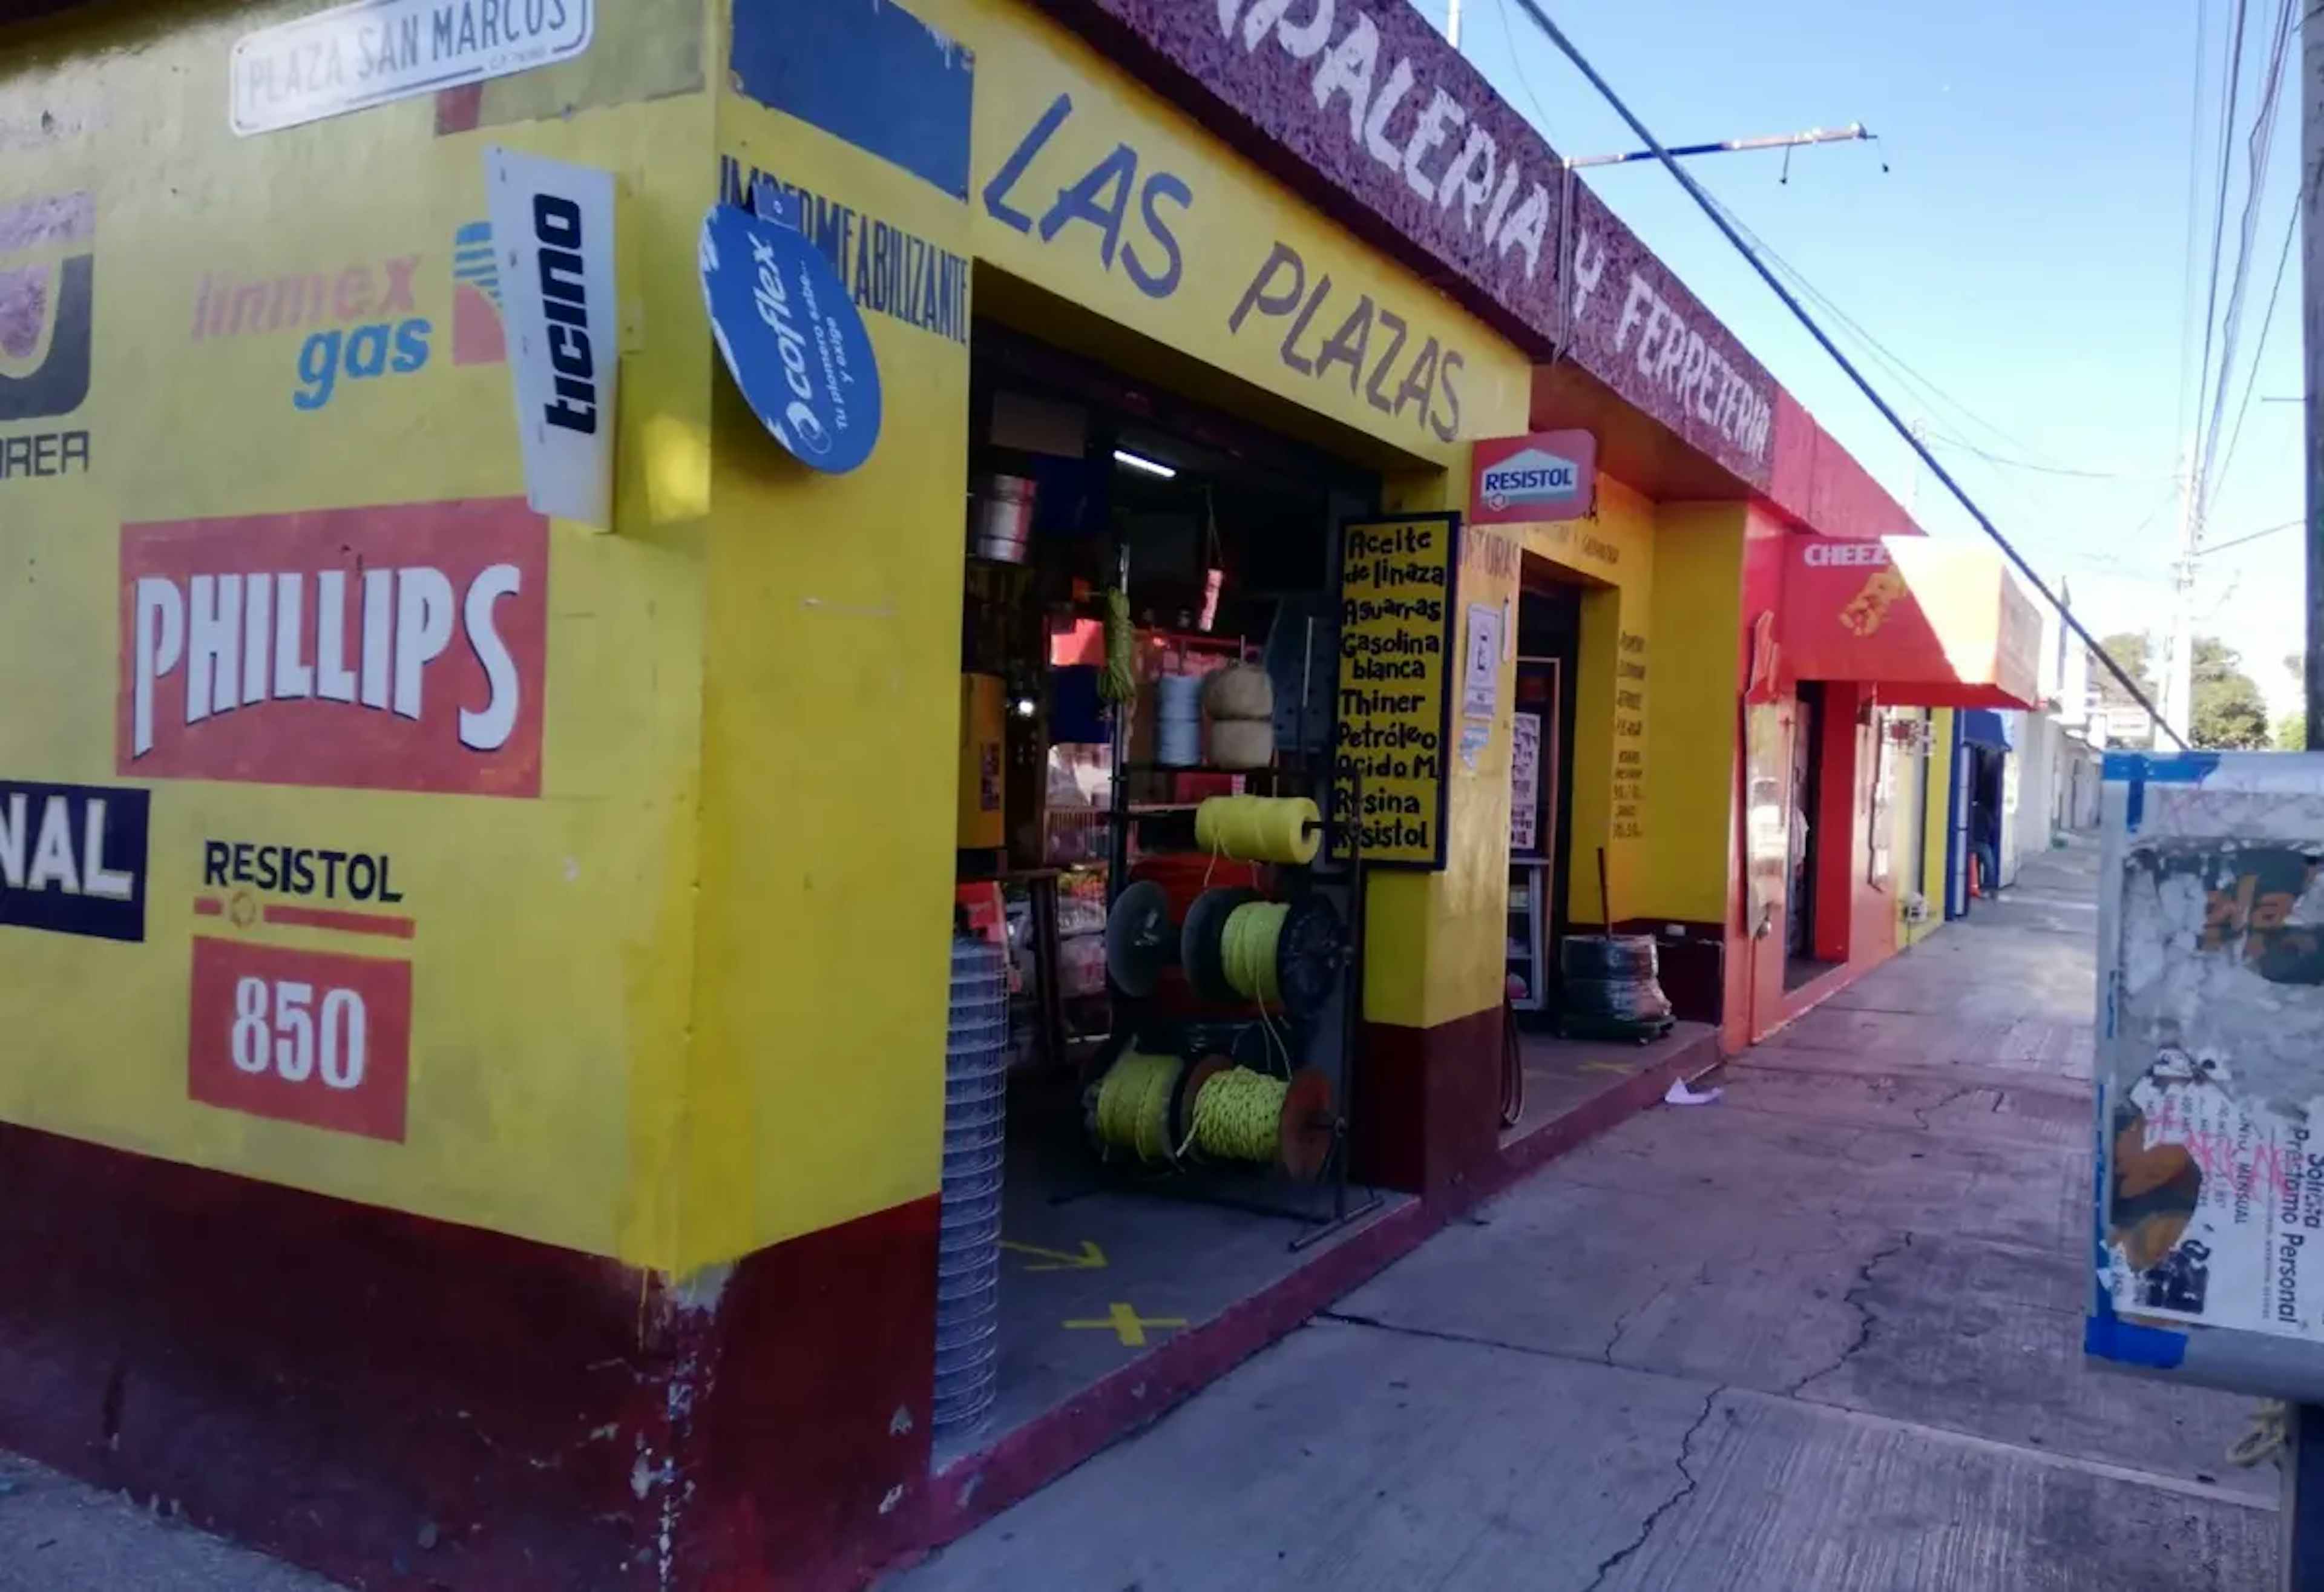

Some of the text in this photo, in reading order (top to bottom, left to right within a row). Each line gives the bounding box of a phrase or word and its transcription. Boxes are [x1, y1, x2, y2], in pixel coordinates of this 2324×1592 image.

[249, 0, 566, 110] PLAZA SAN MARCOS
[983, 91, 1464, 443] LAS PLAZAS
[533, 193, 596, 435] ticino
[746, 231, 812, 400] coflex
[826, 315, 855, 384] y exige
[1574, 226, 1606, 319] Y
[1615, 271, 1772, 462] FERRETERIA
[293, 318, 433, 411] gas
[813, 324, 845, 405] plomero
[1485, 468, 1574, 492] RESISTOL
[1343, 558, 1445, 589] de linaza
[1346, 526, 1432, 559] Aceite
[131, 563, 522, 761] PHILLIPS
[1342, 628, 1440, 658] Gasolina
[1352, 657, 1426, 681] blanca
[1338, 720, 1437, 750] Petróleo
[1339, 689, 1426, 716] Thiner
[203, 840, 404, 903] RESISTOL
[231, 976, 367, 1091] 850
[2277, 1232, 2305, 1324] Personal
